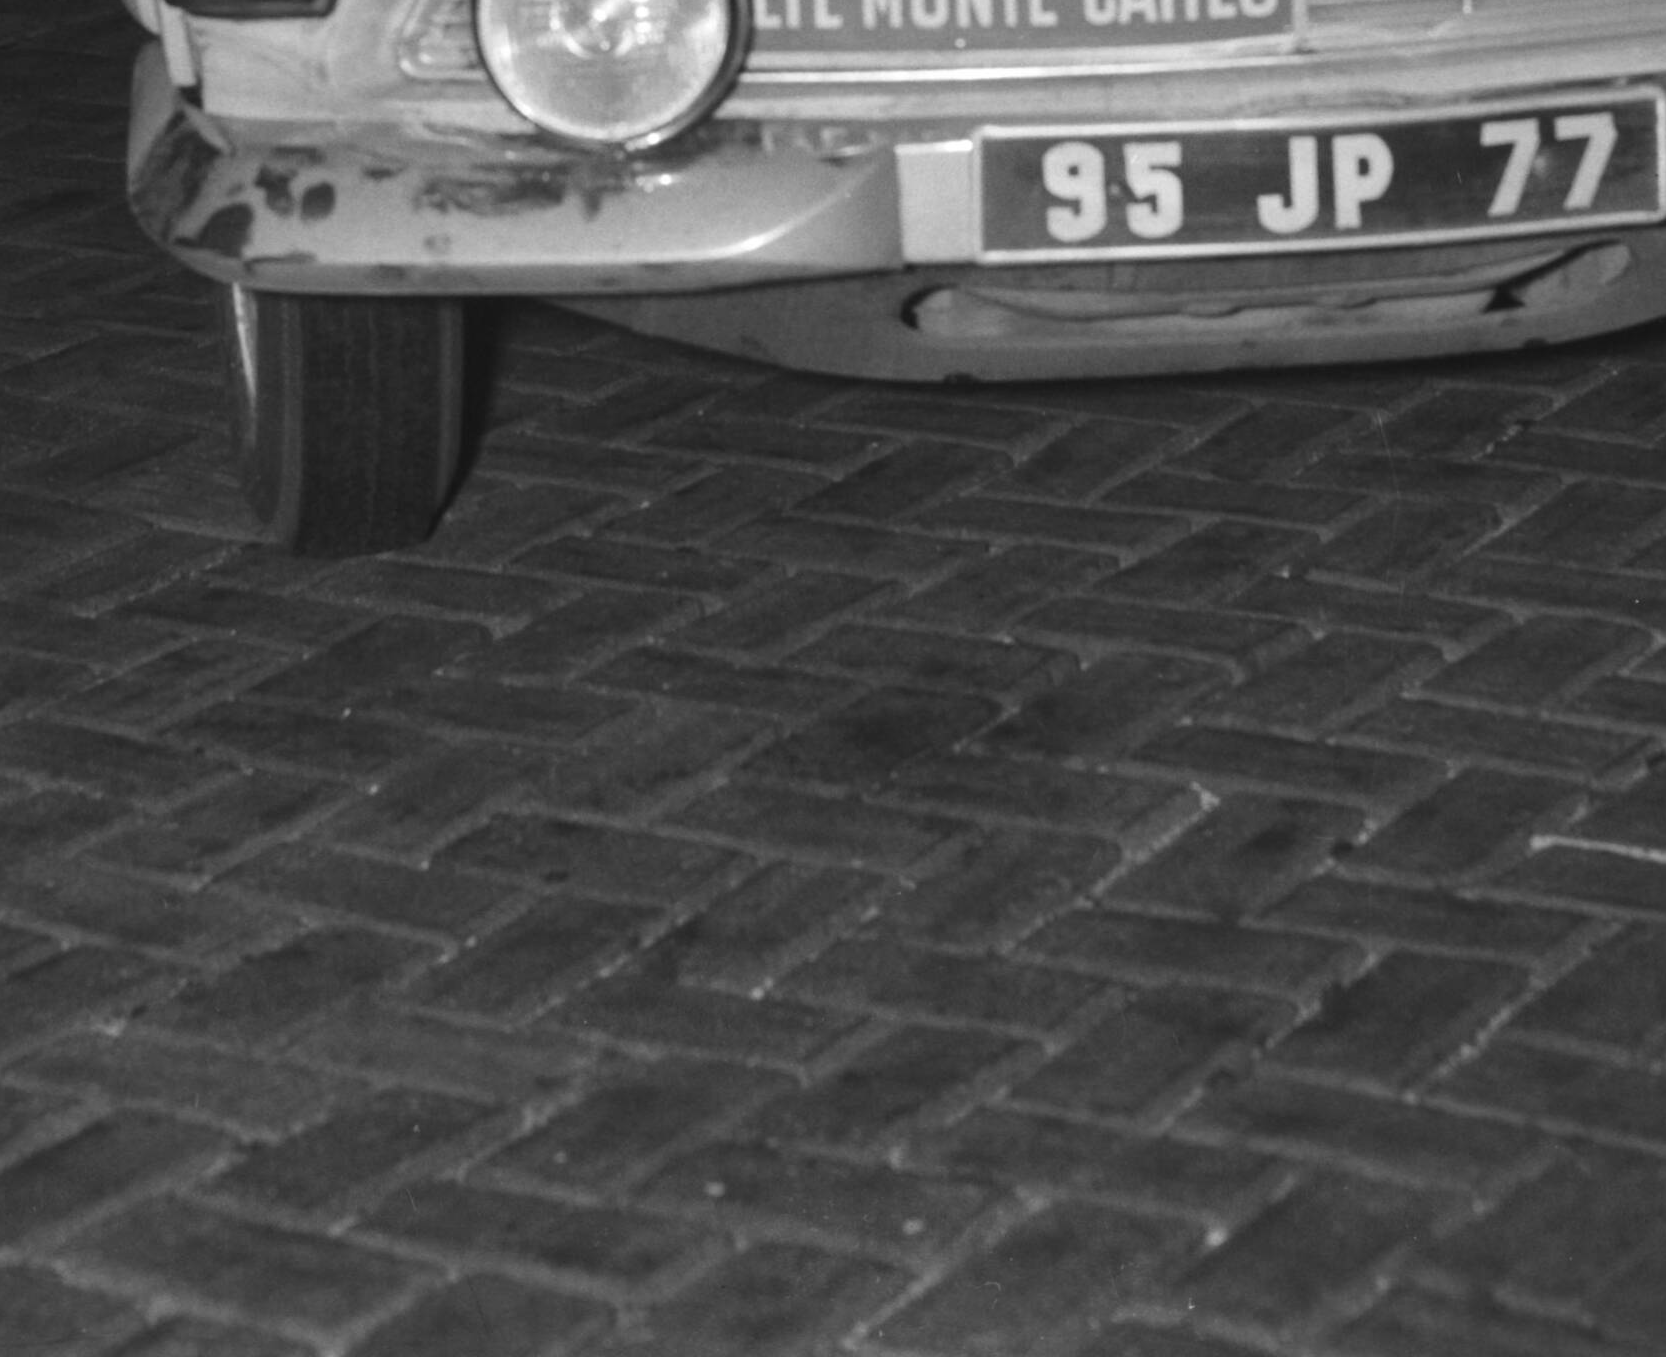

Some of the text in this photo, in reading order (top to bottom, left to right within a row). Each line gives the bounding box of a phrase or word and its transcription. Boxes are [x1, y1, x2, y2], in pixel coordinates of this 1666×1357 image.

[1042, 112, 1618, 242] 95 JP 77
